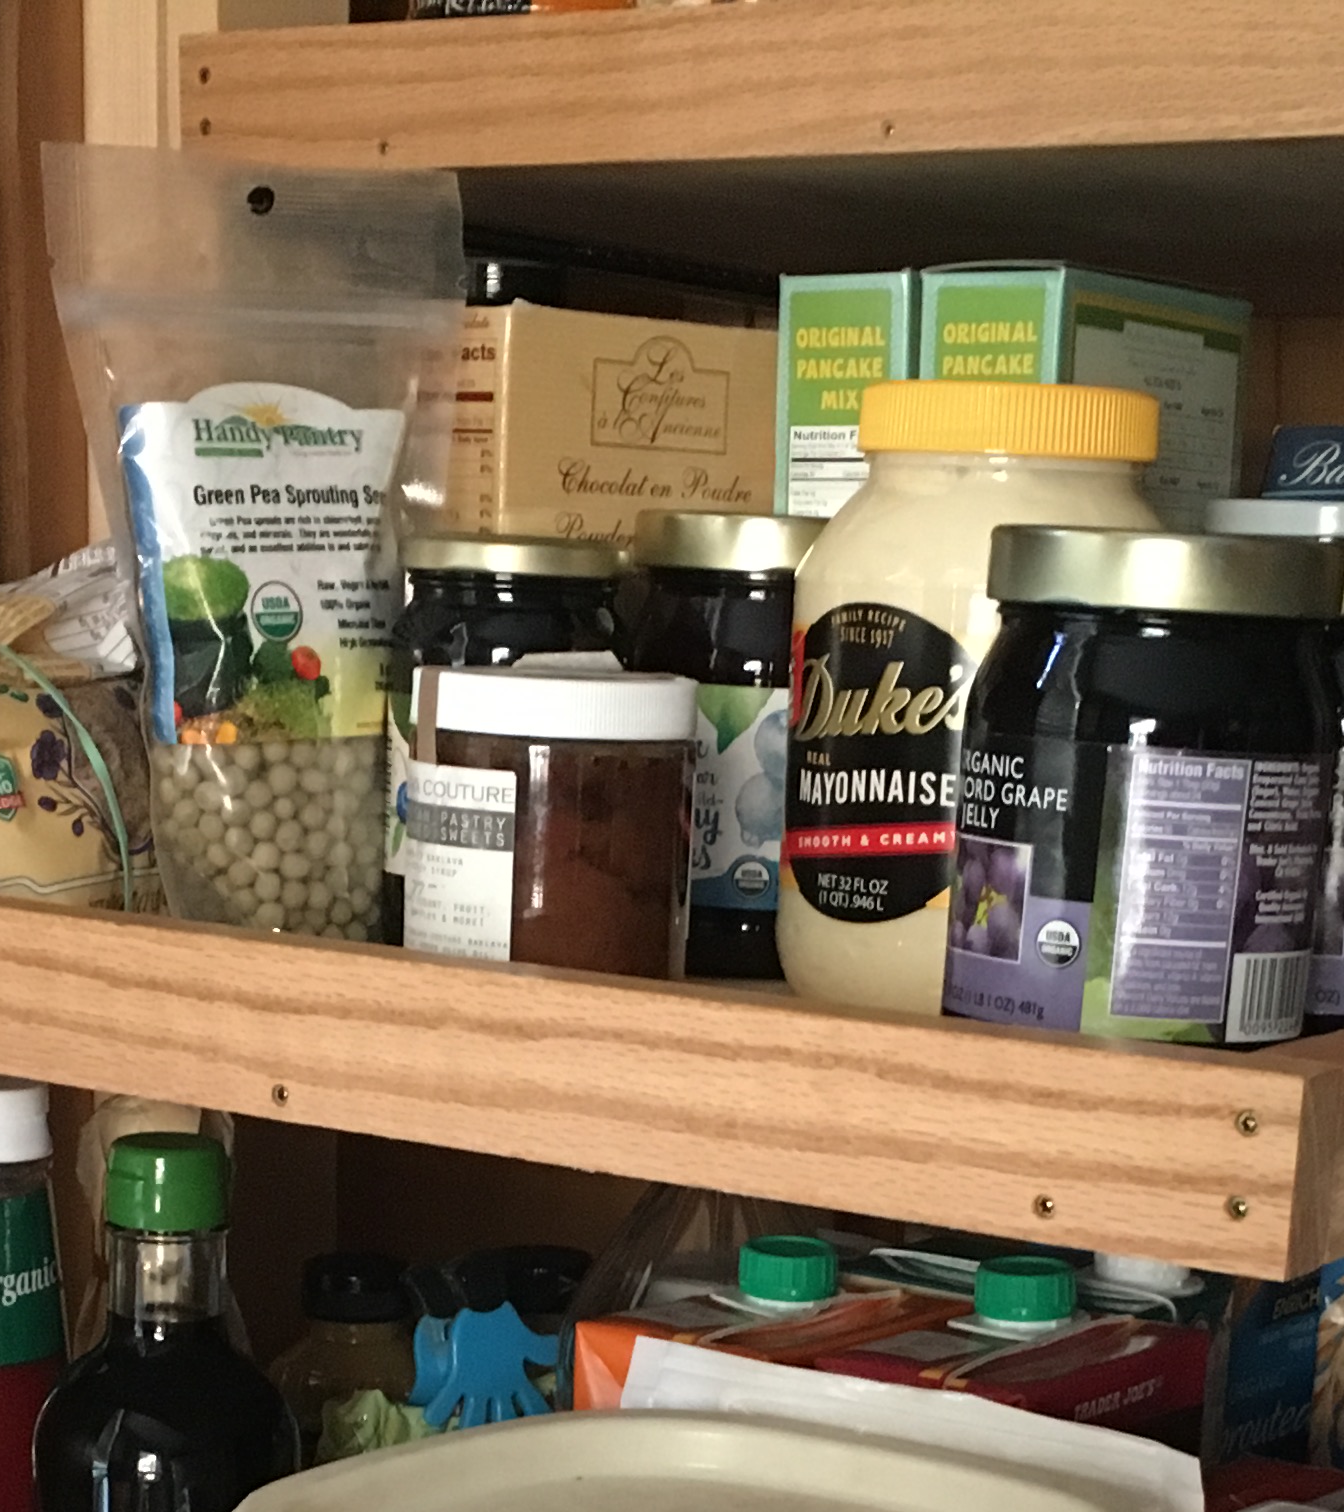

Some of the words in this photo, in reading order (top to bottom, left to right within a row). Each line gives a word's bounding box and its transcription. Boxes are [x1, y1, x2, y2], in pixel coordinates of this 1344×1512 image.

[795, 326, 886, 348] ORIGINAL
[942, 321, 1038, 345] ORIGINAL
[460, 344, 496, 362] acts
[796, 357, 884, 379] PANCAKE
[942, 353, 1035, 377] PANCAKE
[820, 388, 859, 411] MIX
[192, 417, 272, 450] Handy
[281, 425, 364, 453] Pantry
[793, 430, 846, 442] Nutrition
[557, 456, 650, 498] Chocolat
[650, 484, 673, 499] en
[681, 467, 753, 503] Poudre
[192, 484, 246, 506] Green
[250, 484, 282, 505] Pea
[285, 483, 360, 509] Sprouting
[261, 596, 290, 610] USDA
[867, 610, 907, 633] RECIPE
[840, 626, 867, 644] SINCE
[793, 653, 977, 742] Duke's
[806, 750, 832, 767] REAL
[963, 750, 1025, 779] RGANIC
[1206, 762, 1245, 780] Facts
[423, 779, 515, 804] COUTURE
[799, 767, 957, 808] MAYONNAISE
[963, 779, 995, 802] ORD
[1001, 783, 1069, 812] GRAPE
[440, 811, 507, 832] PASTRY
[960, 803, 1001, 830] JELLY
[440, 827, 506, 848] SWEETS
[798, 834, 852, 849] SMOOTH
[859, 833, 870, 847] &
[817, 873, 837, 889] NET
[838, 874, 853, 890] 32
[854, 877, 868, 893] FL
[869, 879, 889, 896] OZ
[876, 898, 885, 911] L
[1045, 930, 1071, 943] USDA
[1272, 1286, 1319, 1320] ENRICH
[1074, 1390, 1121, 1422] TRADER
[1122, 1377, 1155, 1406] JOE'S
